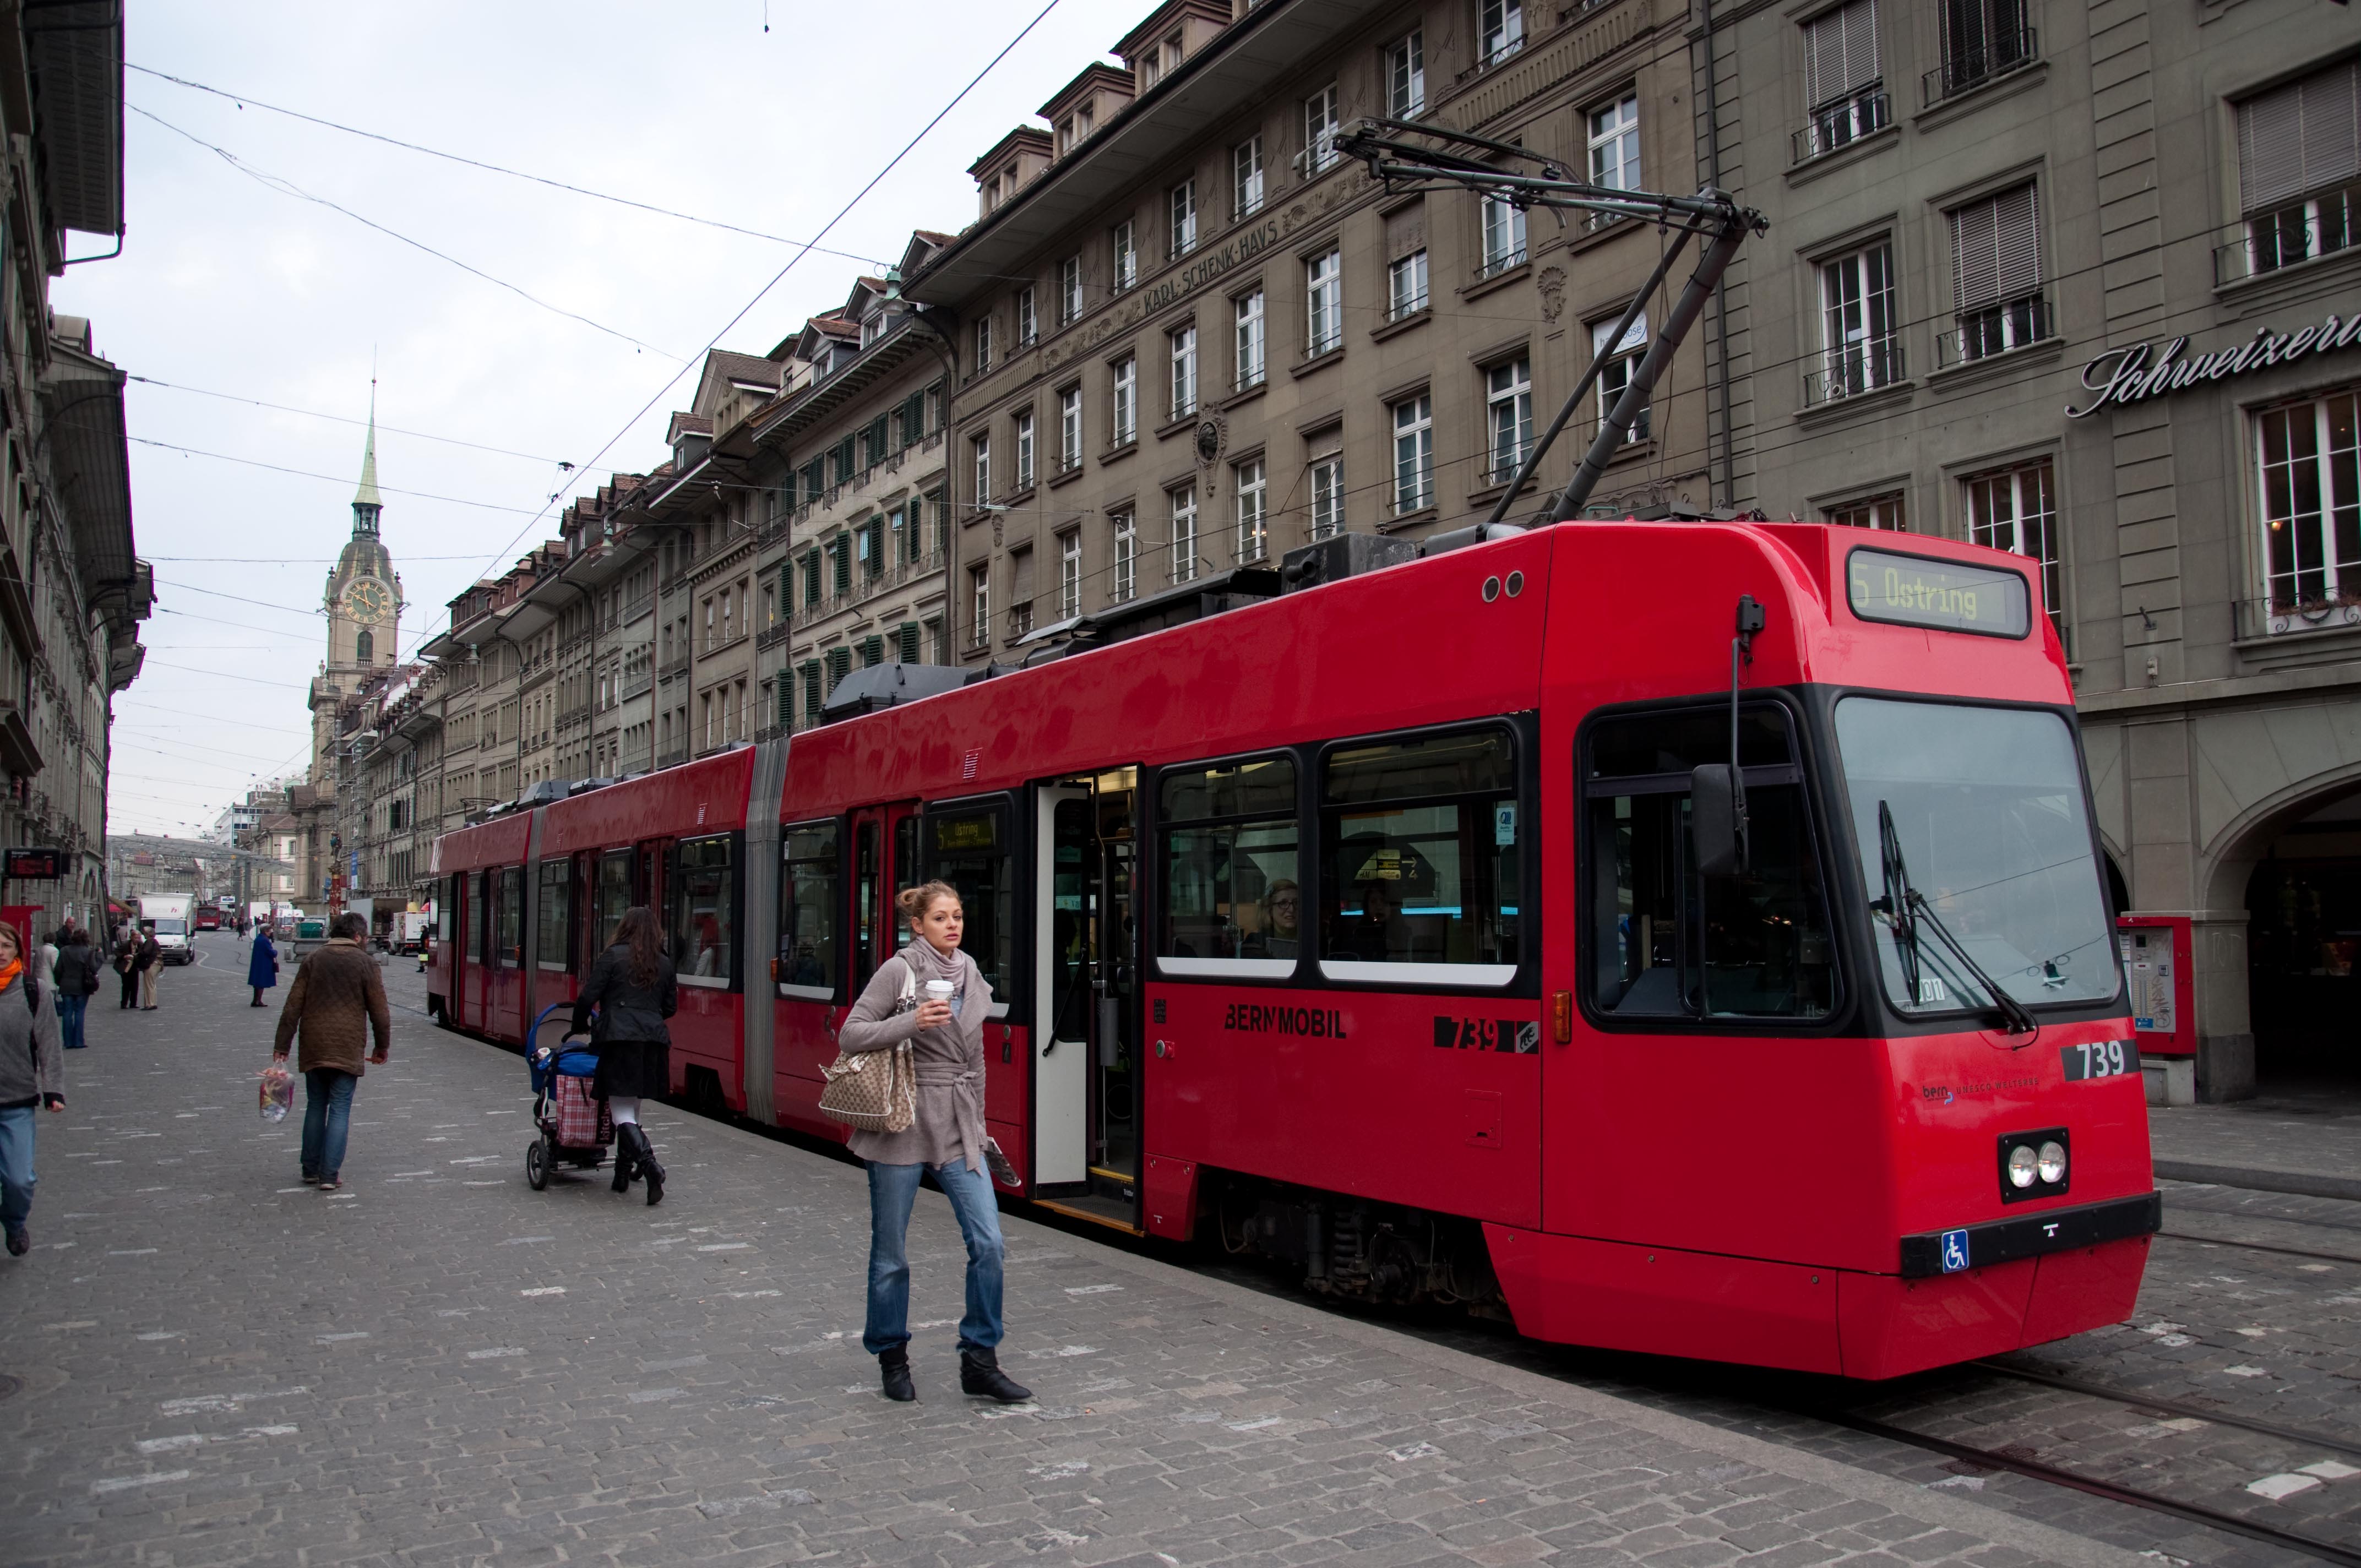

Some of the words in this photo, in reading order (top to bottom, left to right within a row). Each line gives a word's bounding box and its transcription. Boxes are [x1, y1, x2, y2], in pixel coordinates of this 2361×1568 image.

[1182, 243, 1235, 295] SCHENK
[1851, 562, 1869, 608] 5
[1884, 567, 1977, 620] Ostring
[938, 824, 944, 851] 5
[955, 823, 978, 836] Ostring
[1451, 1016, 1499, 1052] 739
[2076, 1040, 2125, 1079] 739
[1923, 1085, 1948, 1098] bern
[1956, 1083, 1992, 1095] UNESCO
[1995, 1077, 2039, 1090] WELTERBE
